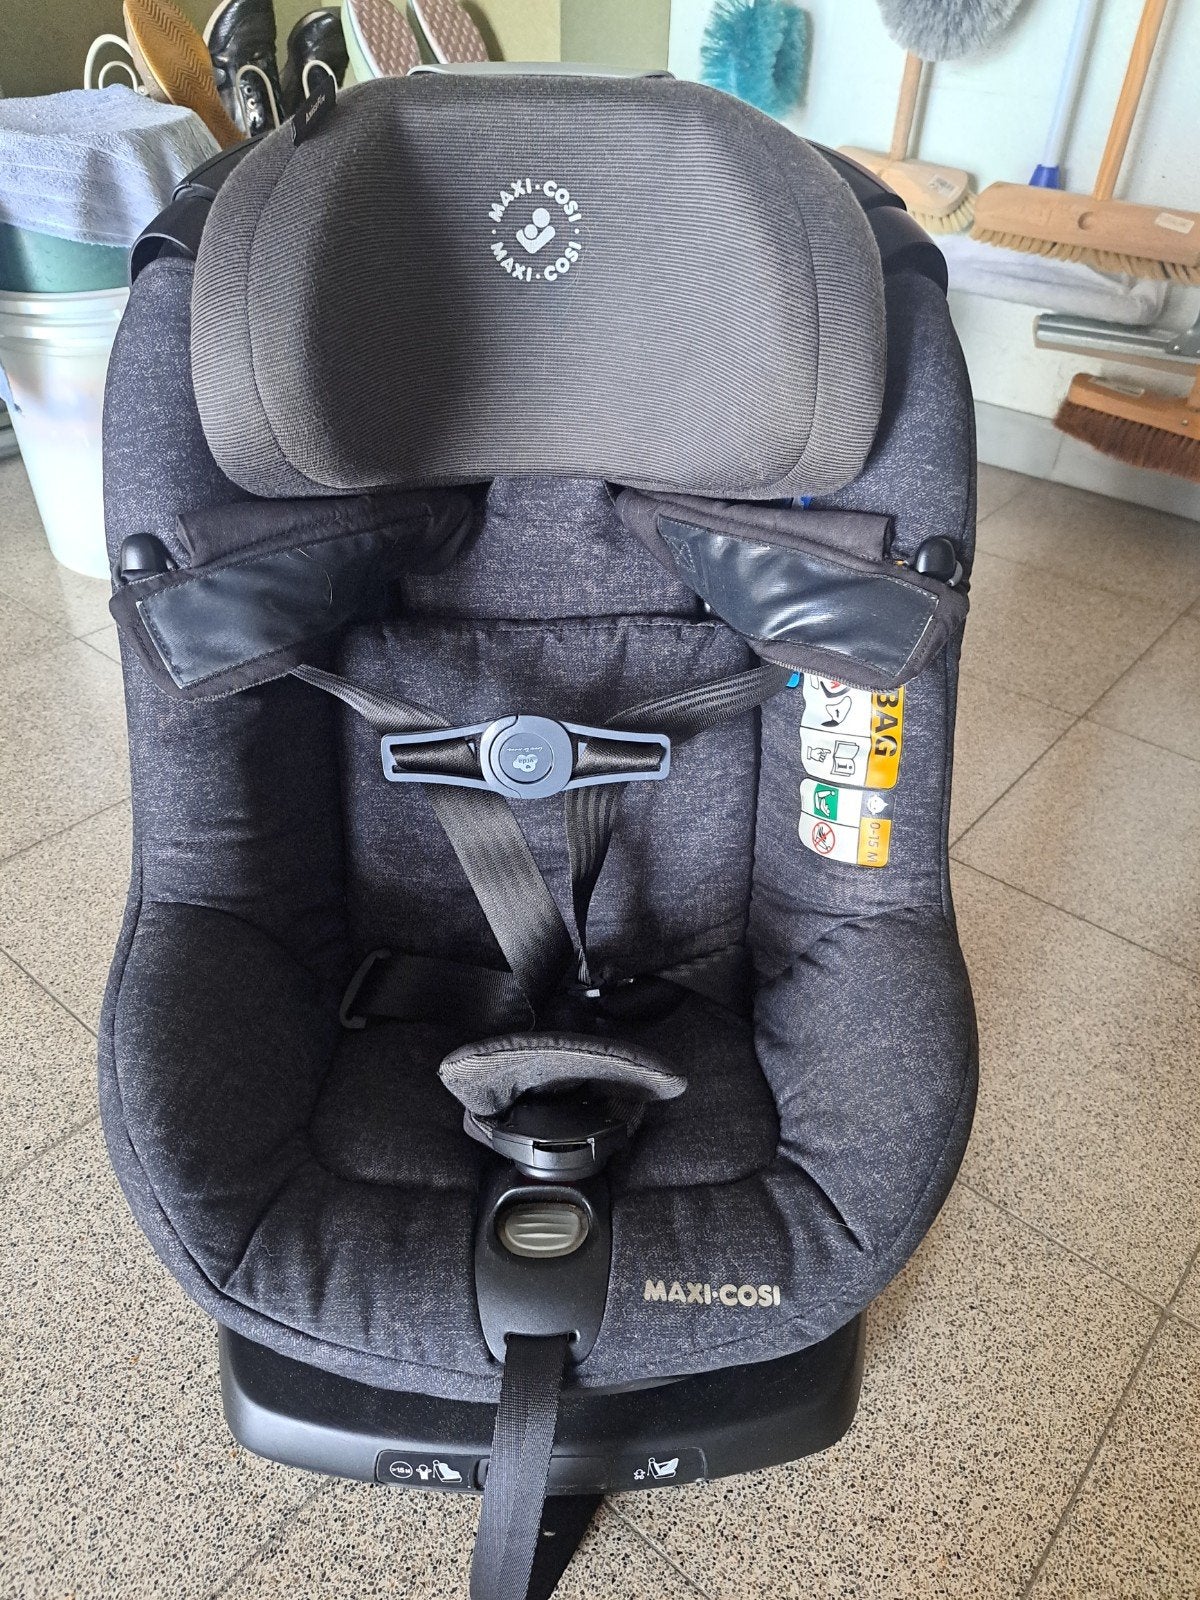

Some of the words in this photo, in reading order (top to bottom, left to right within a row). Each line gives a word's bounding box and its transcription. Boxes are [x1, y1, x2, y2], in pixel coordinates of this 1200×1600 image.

[875, 691, 899, 757] BAG
[868, 822, 881, 848] 0-15
[867, 851, 878, 863] M
